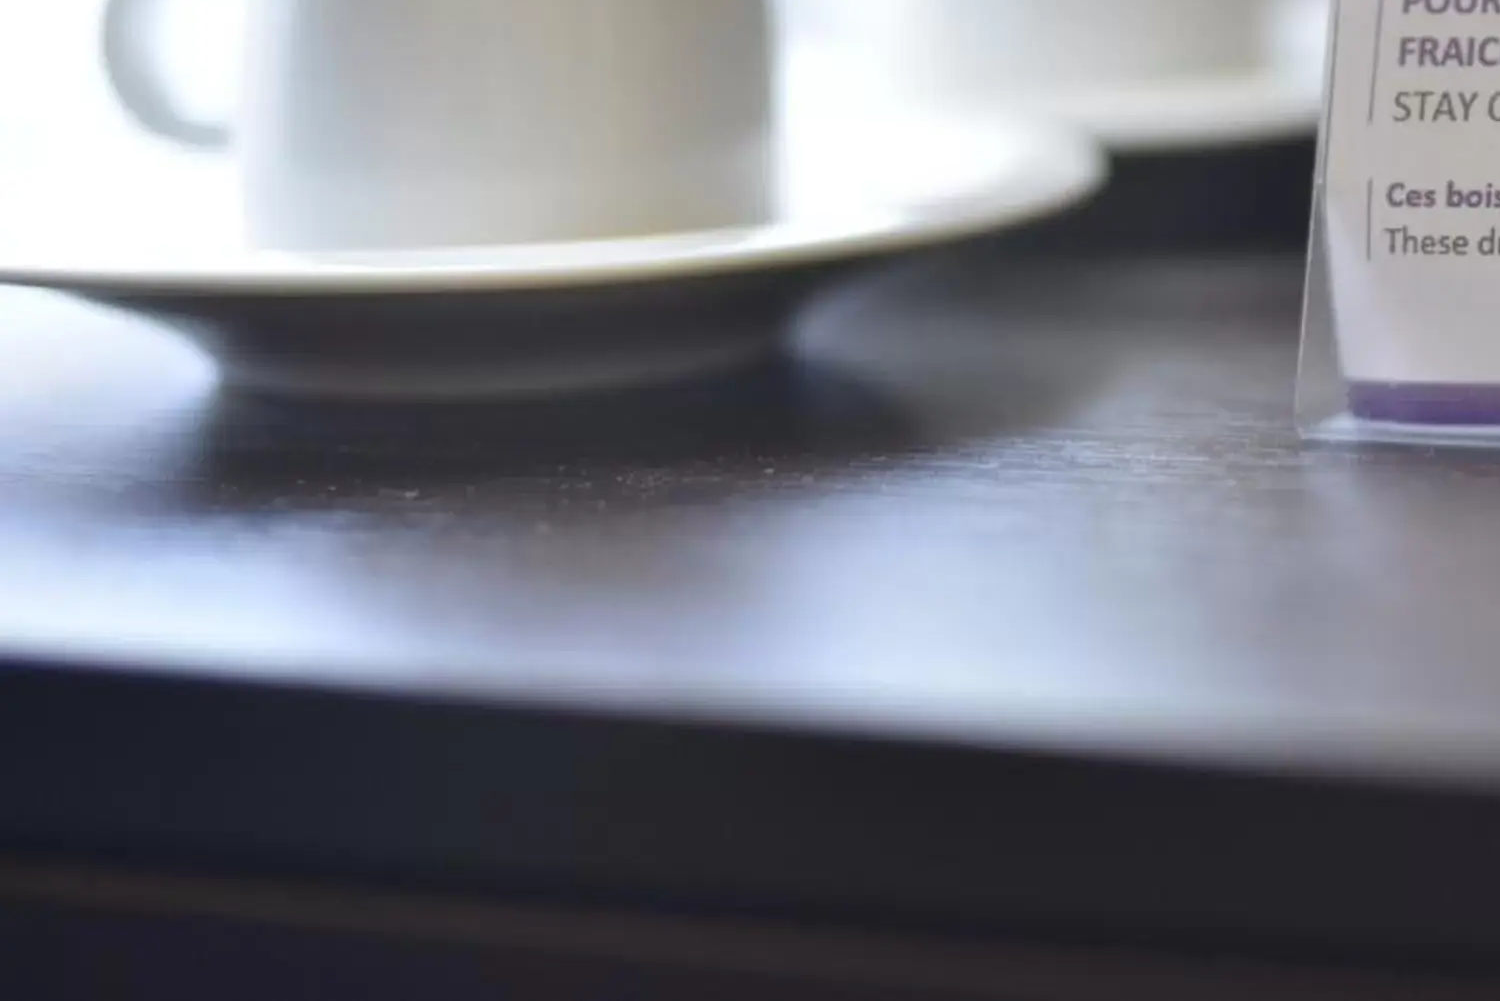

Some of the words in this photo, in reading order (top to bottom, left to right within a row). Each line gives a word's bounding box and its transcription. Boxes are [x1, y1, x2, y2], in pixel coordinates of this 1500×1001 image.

[1393, 90, 1479, 123] STAY
[1385, 182, 1437, 209] Ces
[1383, 225, 1470, 256] These
